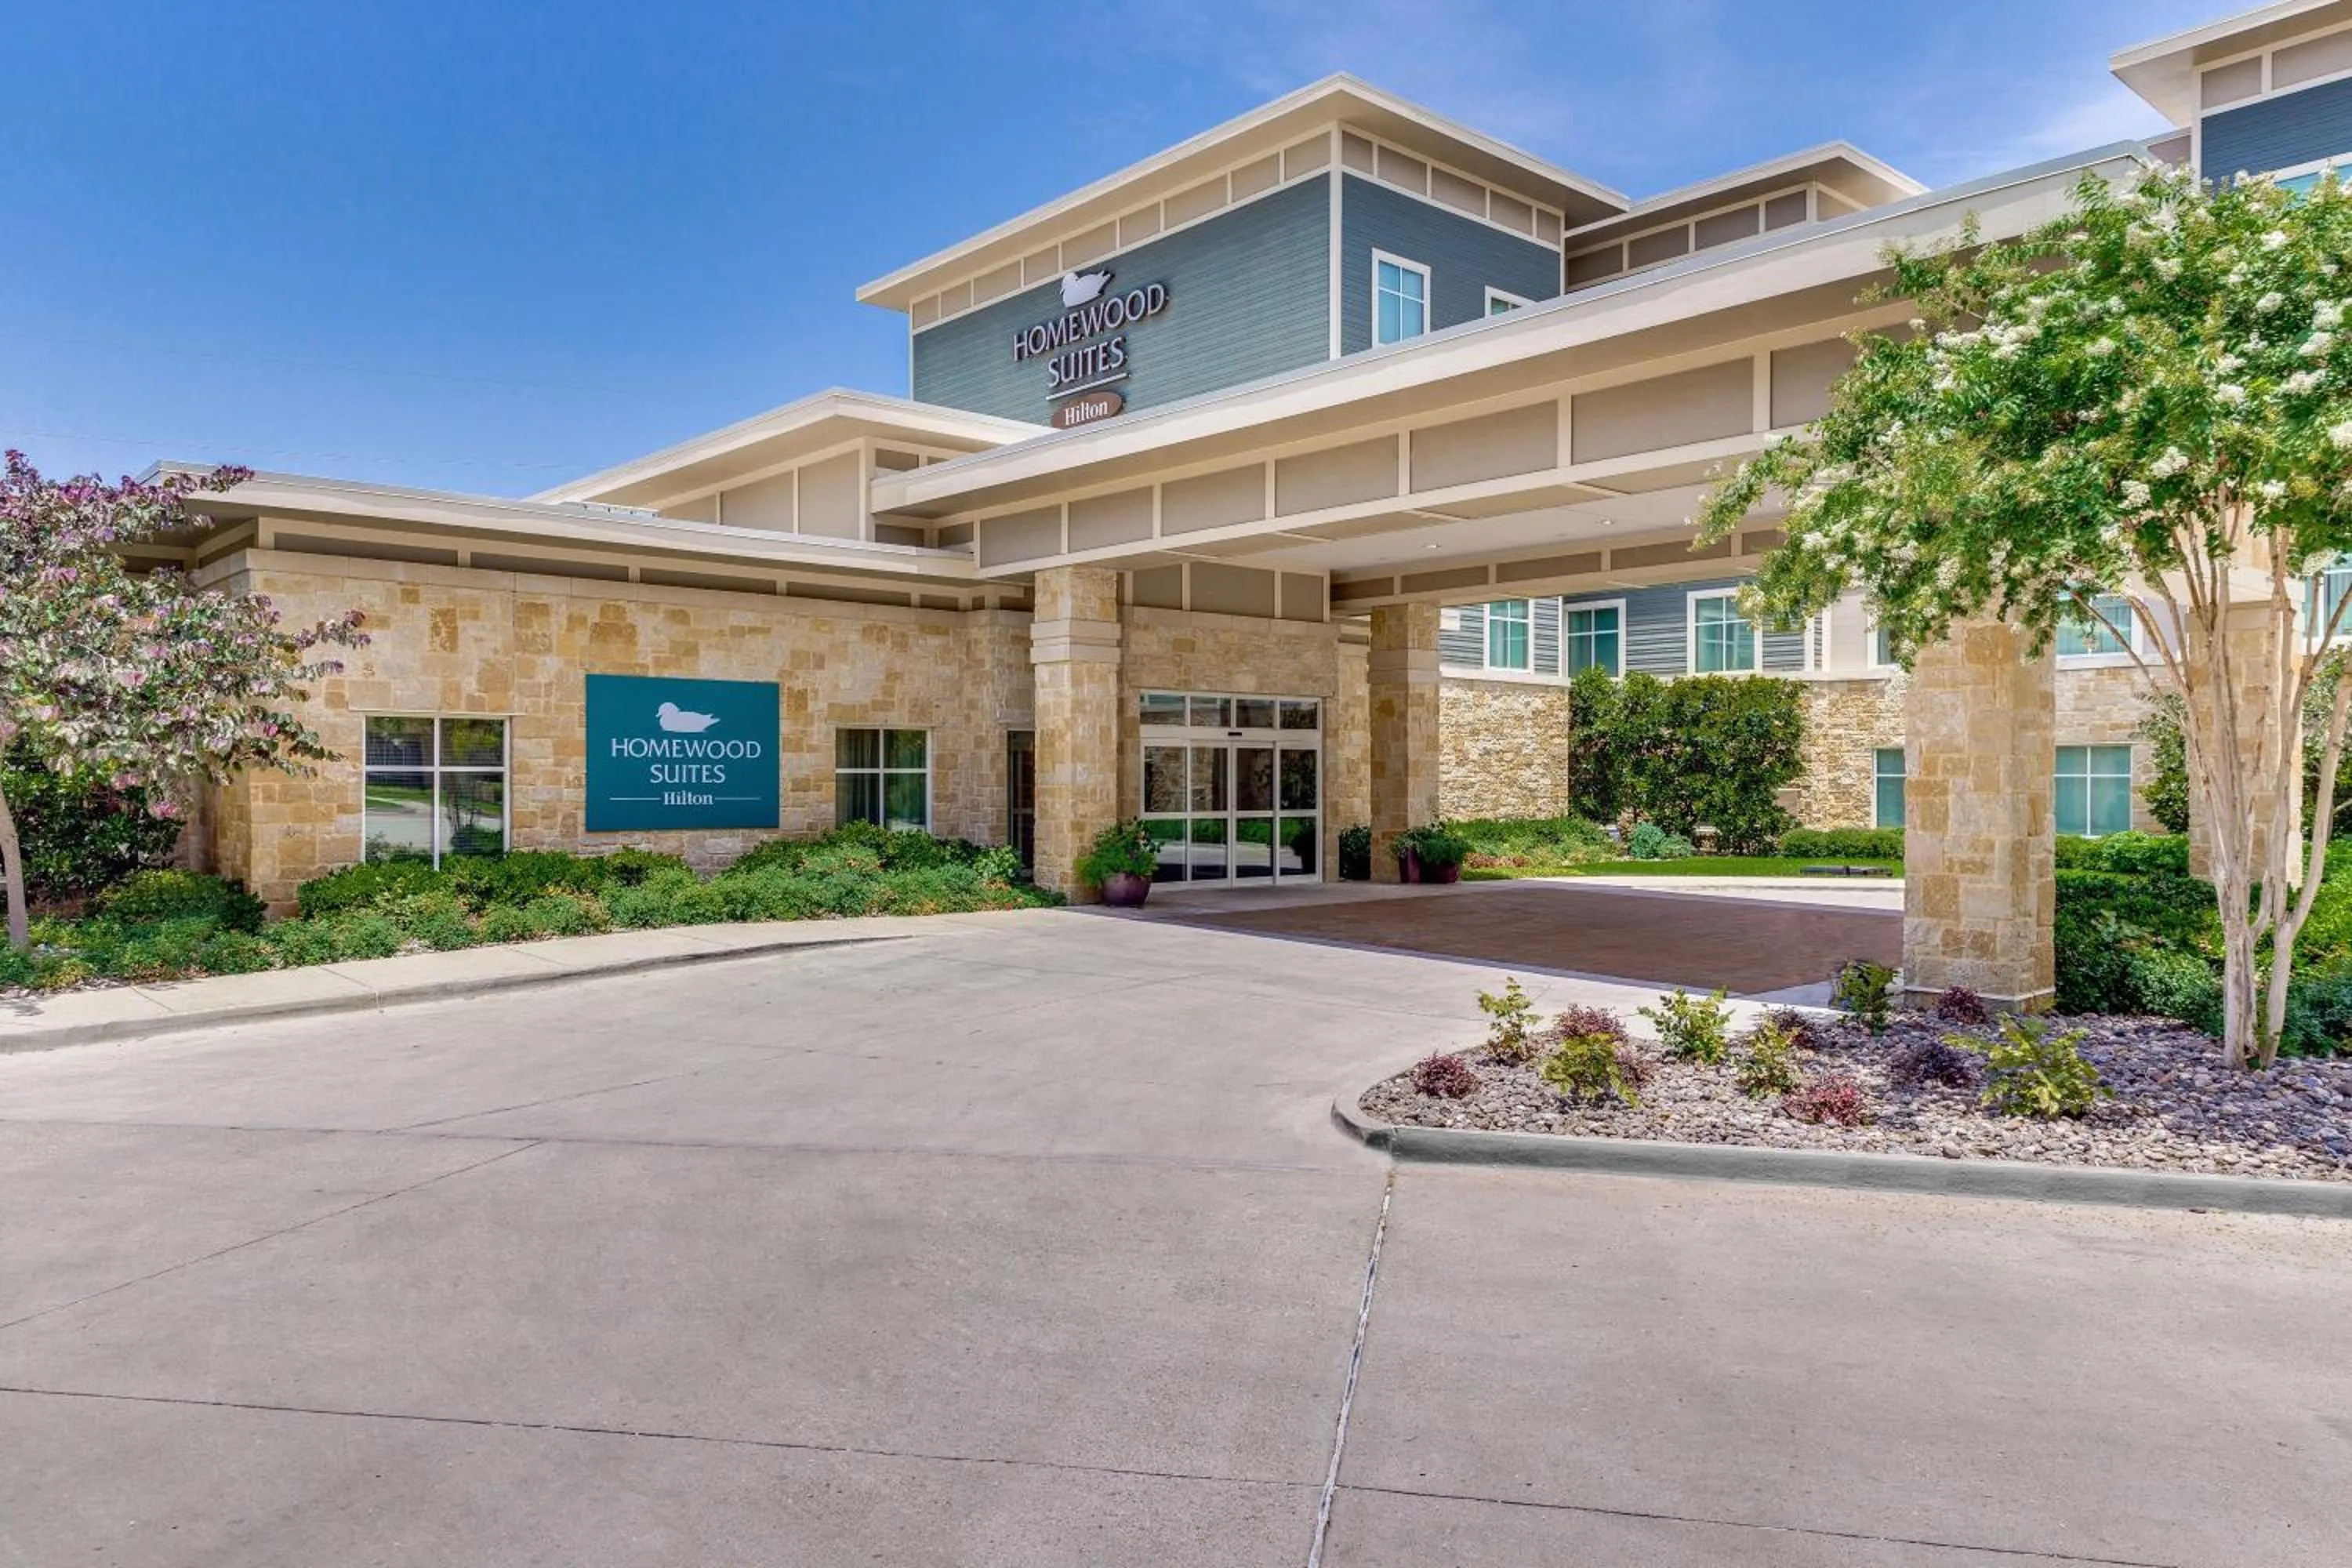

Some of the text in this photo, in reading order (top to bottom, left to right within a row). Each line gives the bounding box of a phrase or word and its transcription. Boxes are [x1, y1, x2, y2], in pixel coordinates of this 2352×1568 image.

[1013, 283, 1167, 361] HOMEWOOD
[1047, 336, 1125, 387] SUITES
[1065, 400, 1109, 426] Hilton
[611, 738, 761, 759] HOMEWOOD
[650, 764, 725, 783] SUITES
[662, 790, 713, 805] Hilton
